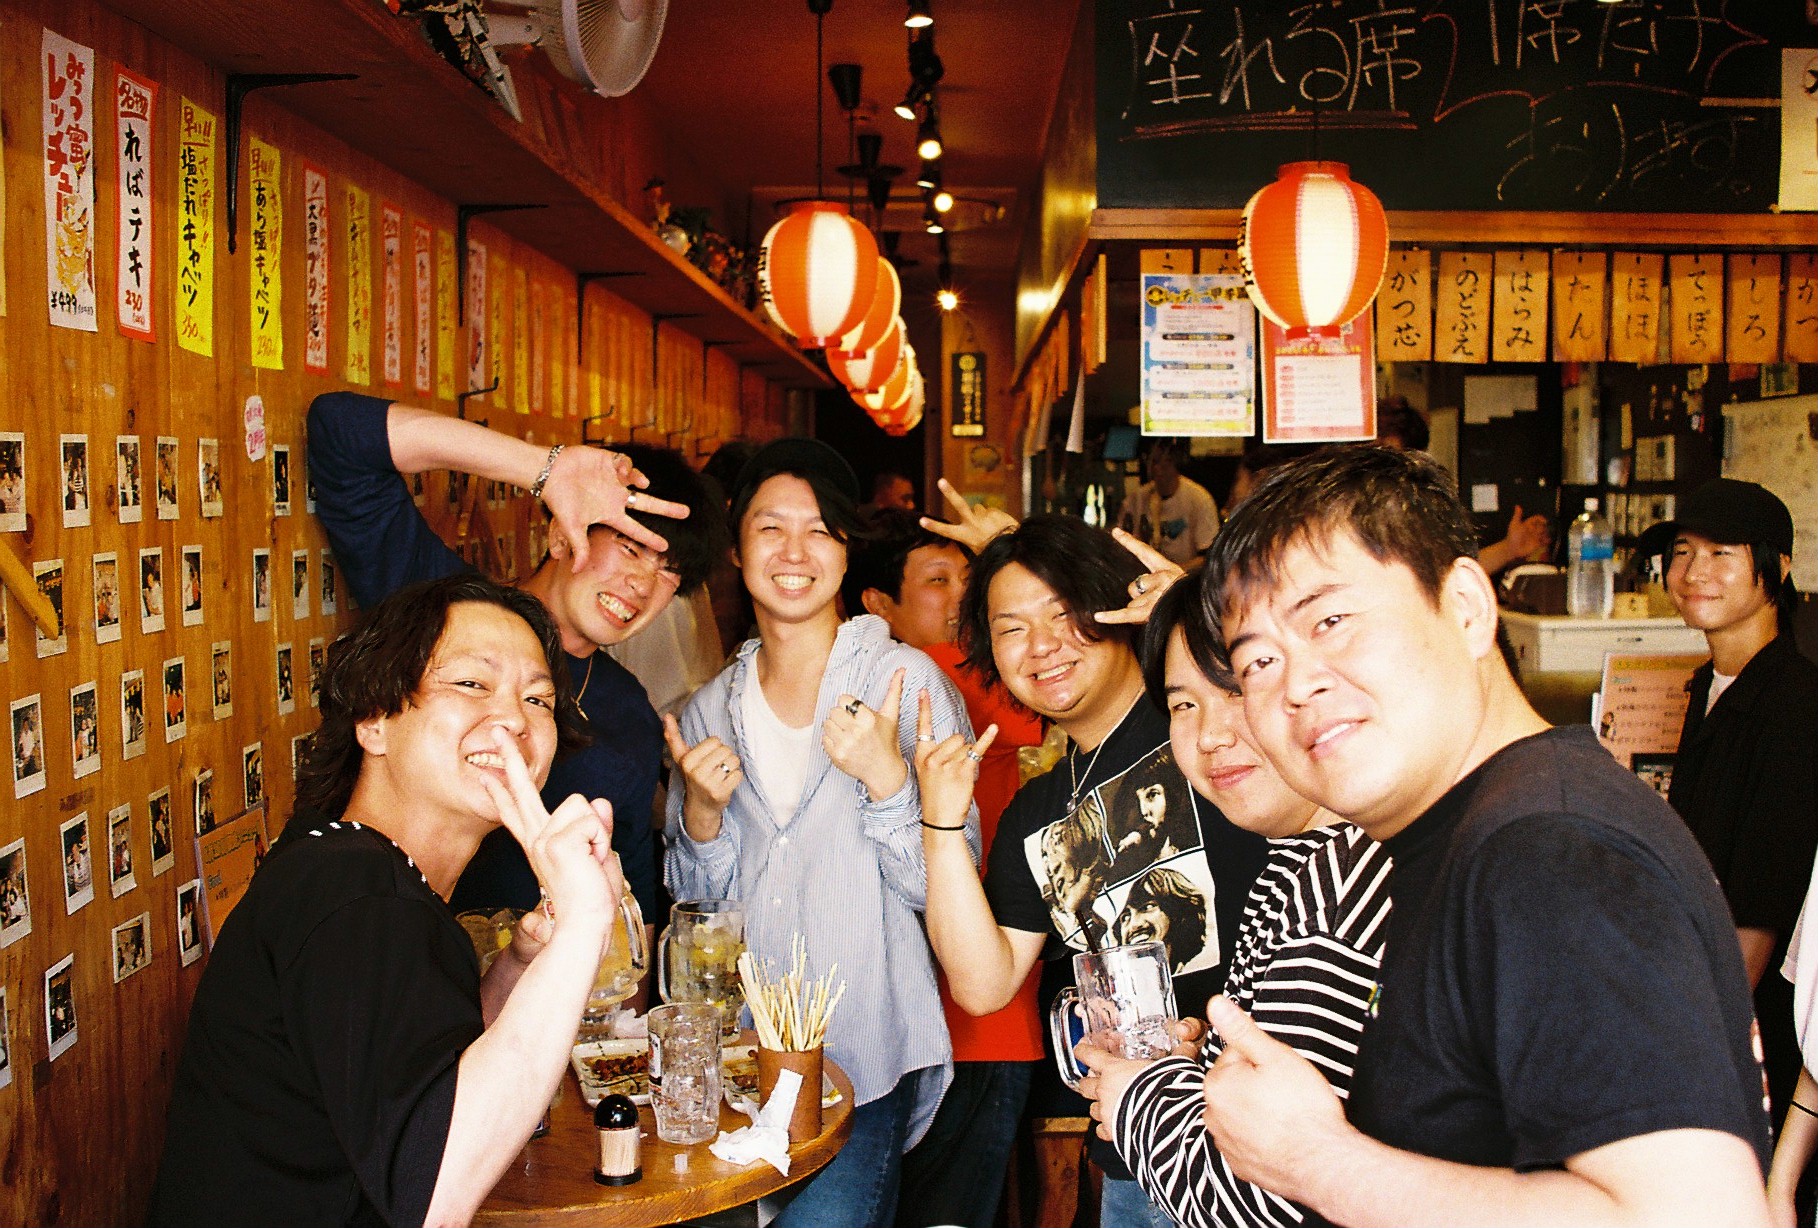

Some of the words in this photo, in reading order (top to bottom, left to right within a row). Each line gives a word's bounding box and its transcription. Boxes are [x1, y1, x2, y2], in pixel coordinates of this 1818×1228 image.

[1120, 0, 1422, 112] 座れる席
[118, 80, 149, 117] 名物
[124, 121, 144, 289] ればテキ
[181, 146, 202, 308] 塩だれキャベツ
[1391, 267, 1421, 348] がつ芯
[1451, 269, 1480, 356] のどぶえ
[1505, 271, 1534, 349] はらみ
[1568, 275, 1598, 341] たん
